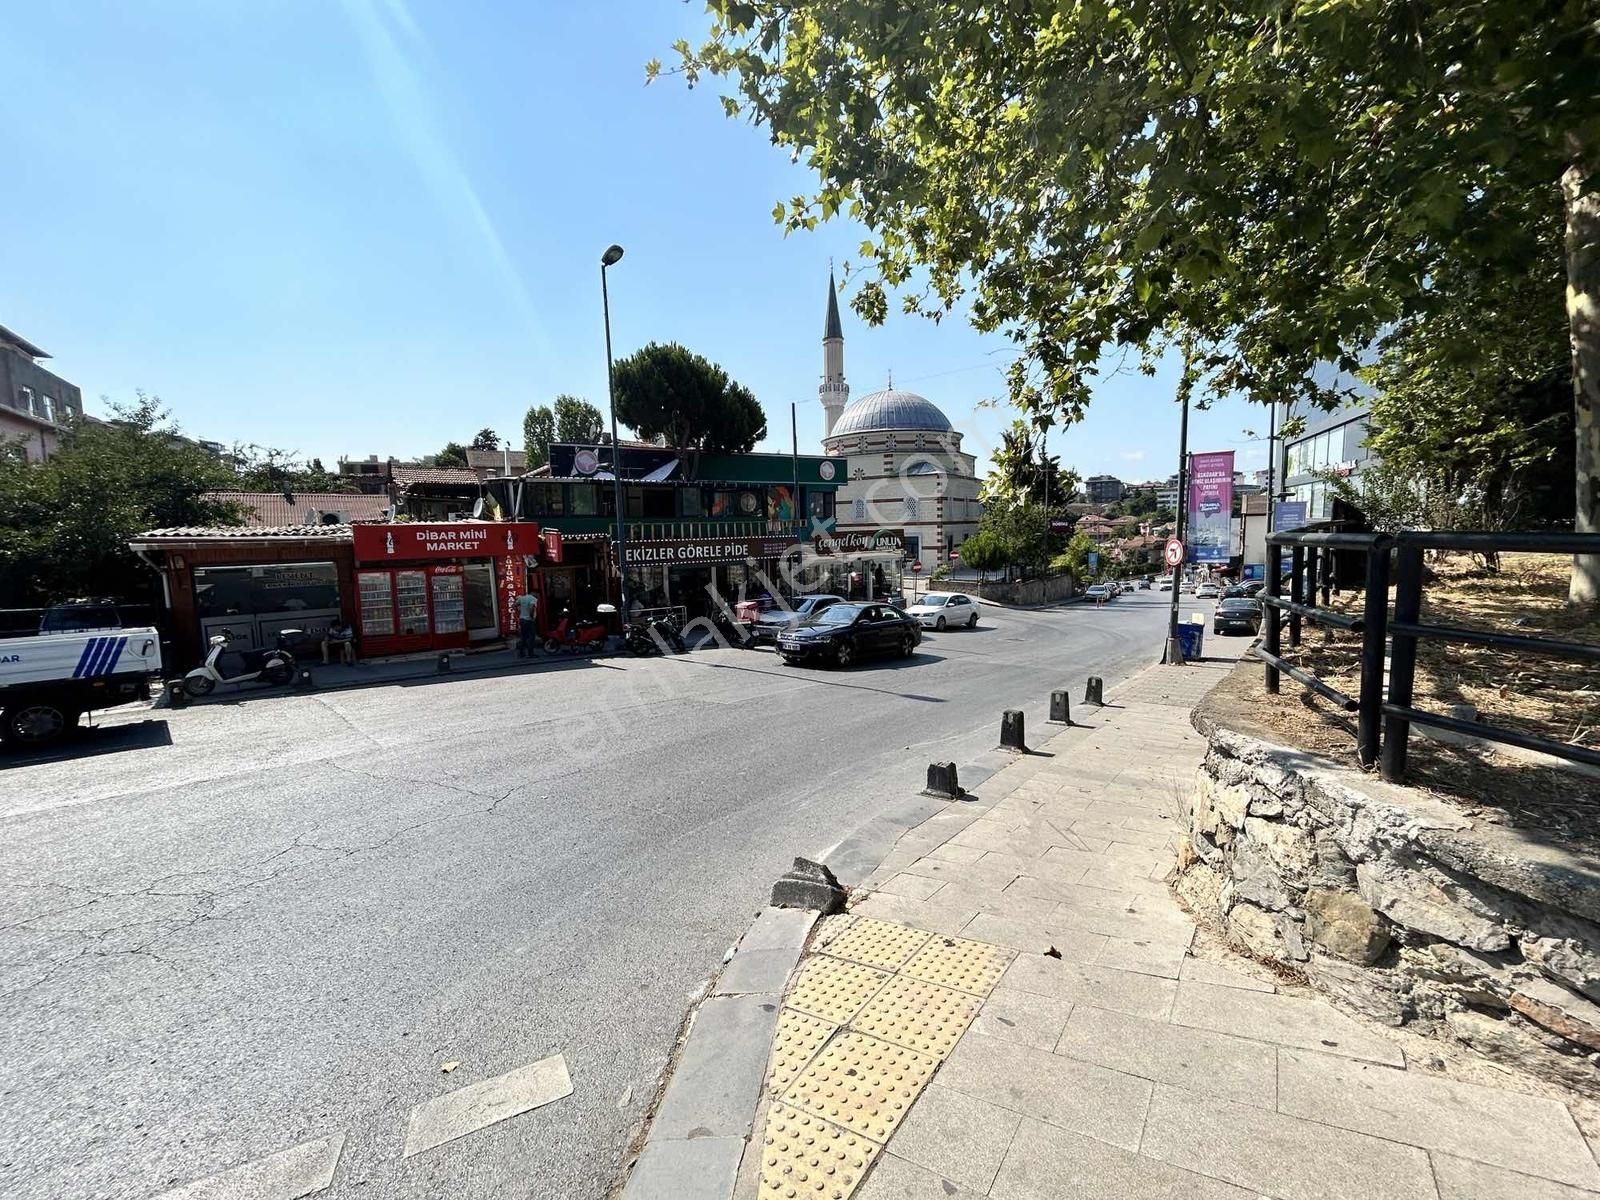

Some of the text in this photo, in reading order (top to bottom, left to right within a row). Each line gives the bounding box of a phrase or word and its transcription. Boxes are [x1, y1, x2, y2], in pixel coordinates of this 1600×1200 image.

[416, 529, 487, 541] DİBAR MİNİ
[426, 541, 480, 551] MARKET
[625, 546, 675, 561] EKİZLER
[677, 544, 722, 559] GÖRELE
[724, 542, 749, 556] PİDE
[0, 655, 20, 663] AR
